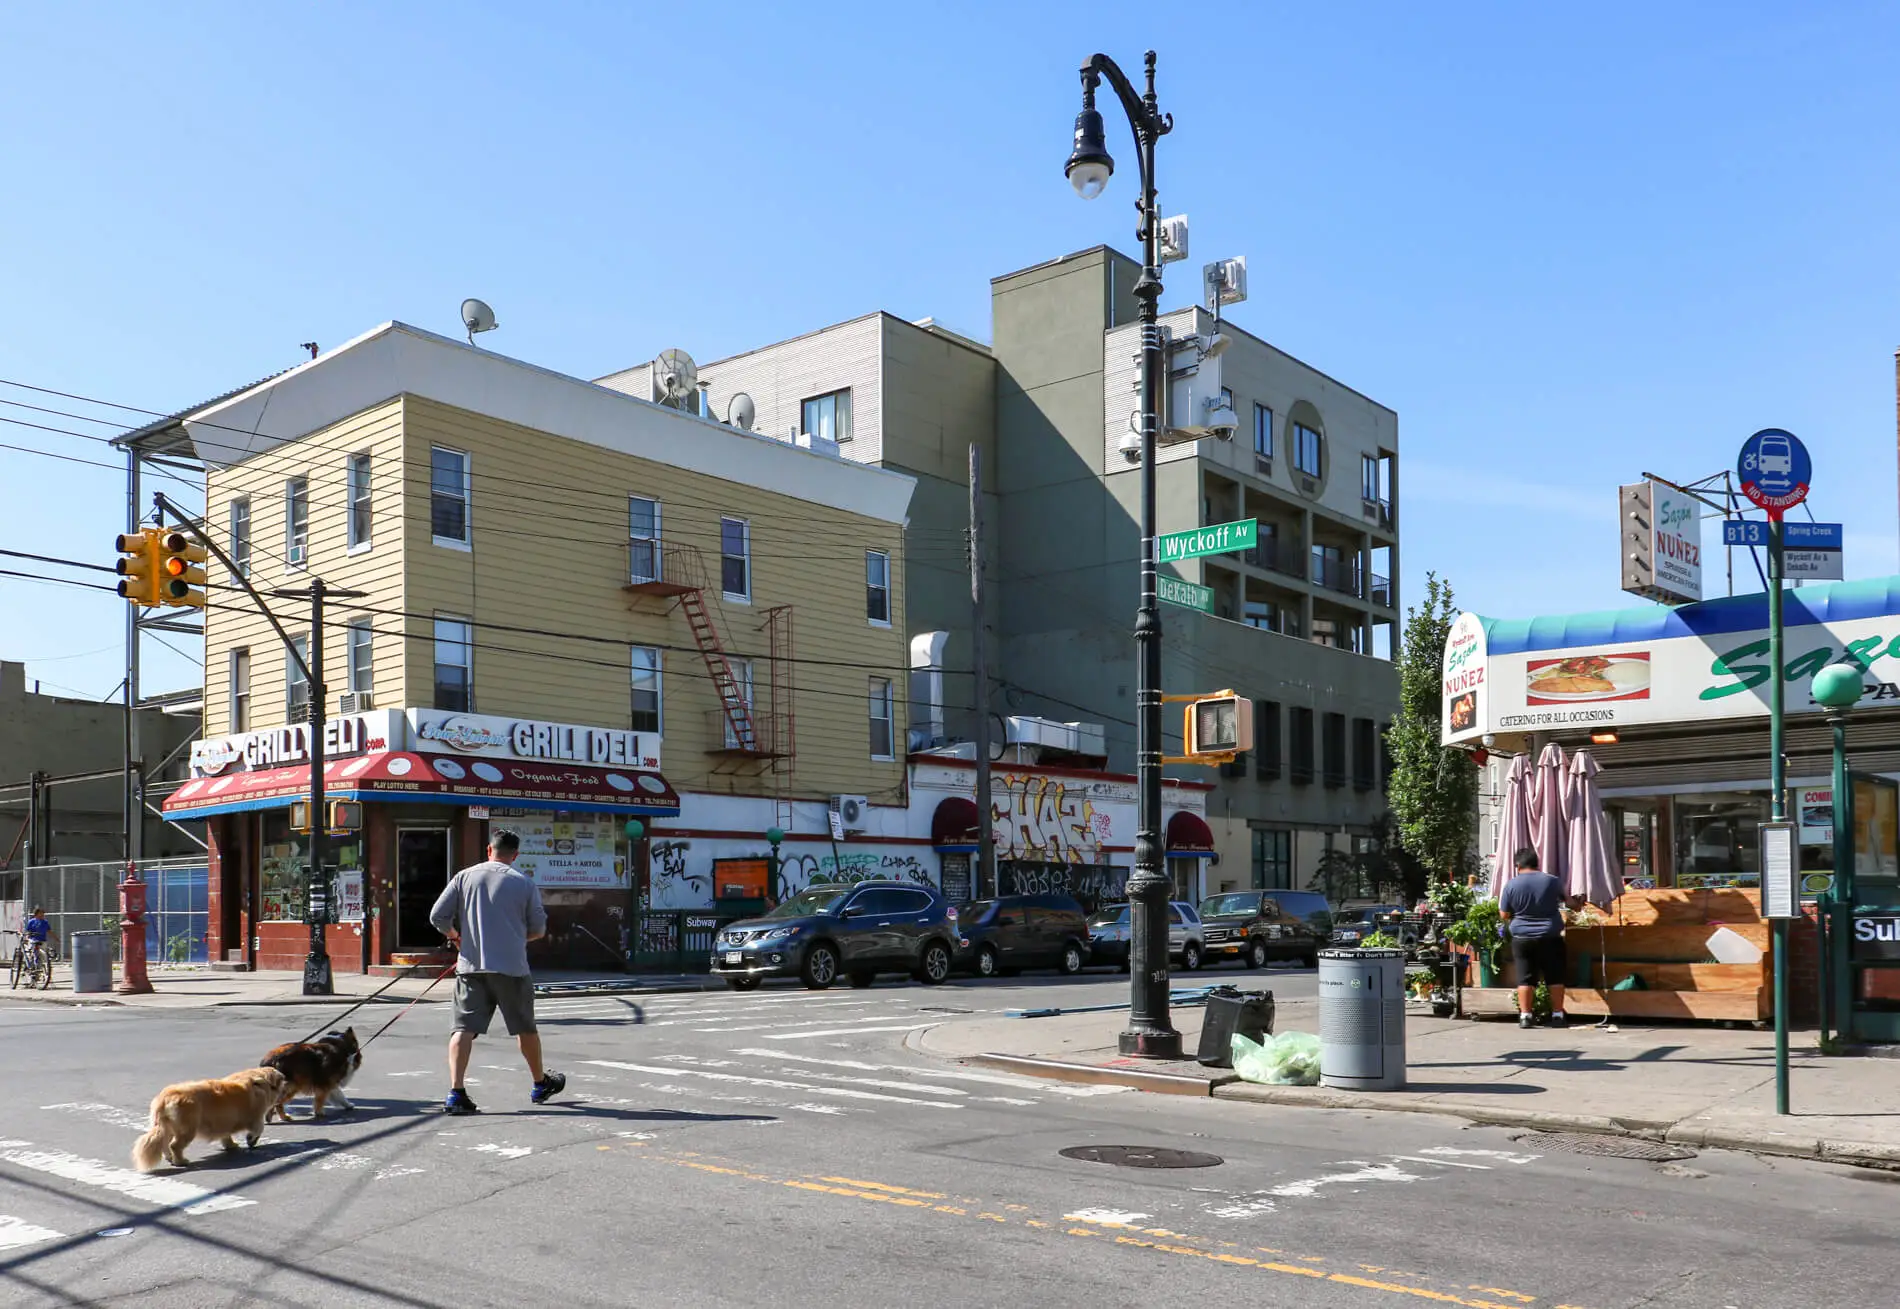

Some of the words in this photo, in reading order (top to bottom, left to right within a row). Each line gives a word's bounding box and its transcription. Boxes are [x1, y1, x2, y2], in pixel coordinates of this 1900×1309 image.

[1747, 486, 1761, 499] NO
[1762, 487, 1805, 506] STANDING
[1727, 524, 1760, 542] B13
[1787, 526, 1811, 536] Spring
[1812, 526, 1833, 536] Creek
[1166, 527, 1229, 559] Wyckoff
[1656, 530, 1700, 567] NUÑEZ
[1786, 552, 1812, 562] Wyckoff
[1160, 579, 1198, 605] DeKalb
[1445, 667, 1485, 696] NUÑEZ
[1500, 715, 1536, 727] CATERING
[1536, 713, 1552, 724] FOR
[1553, 712, 1569, 723] ALL
[1569, 709, 1614, 722] OCCASIONS
[244, 724, 304, 767] GRILL
[512, 722, 585, 761] GRILL
[510, 768, 564, 783] Organic
[564, 772, 600, 785] Food
[651, 840, 692, 864] FAT
[549, 859, 572, 867] STELLA
[580, 860, 603, 868] ARTOIS
[686, 917, 717, 928] Subway
[1854, 918, 1900, 942] Su
